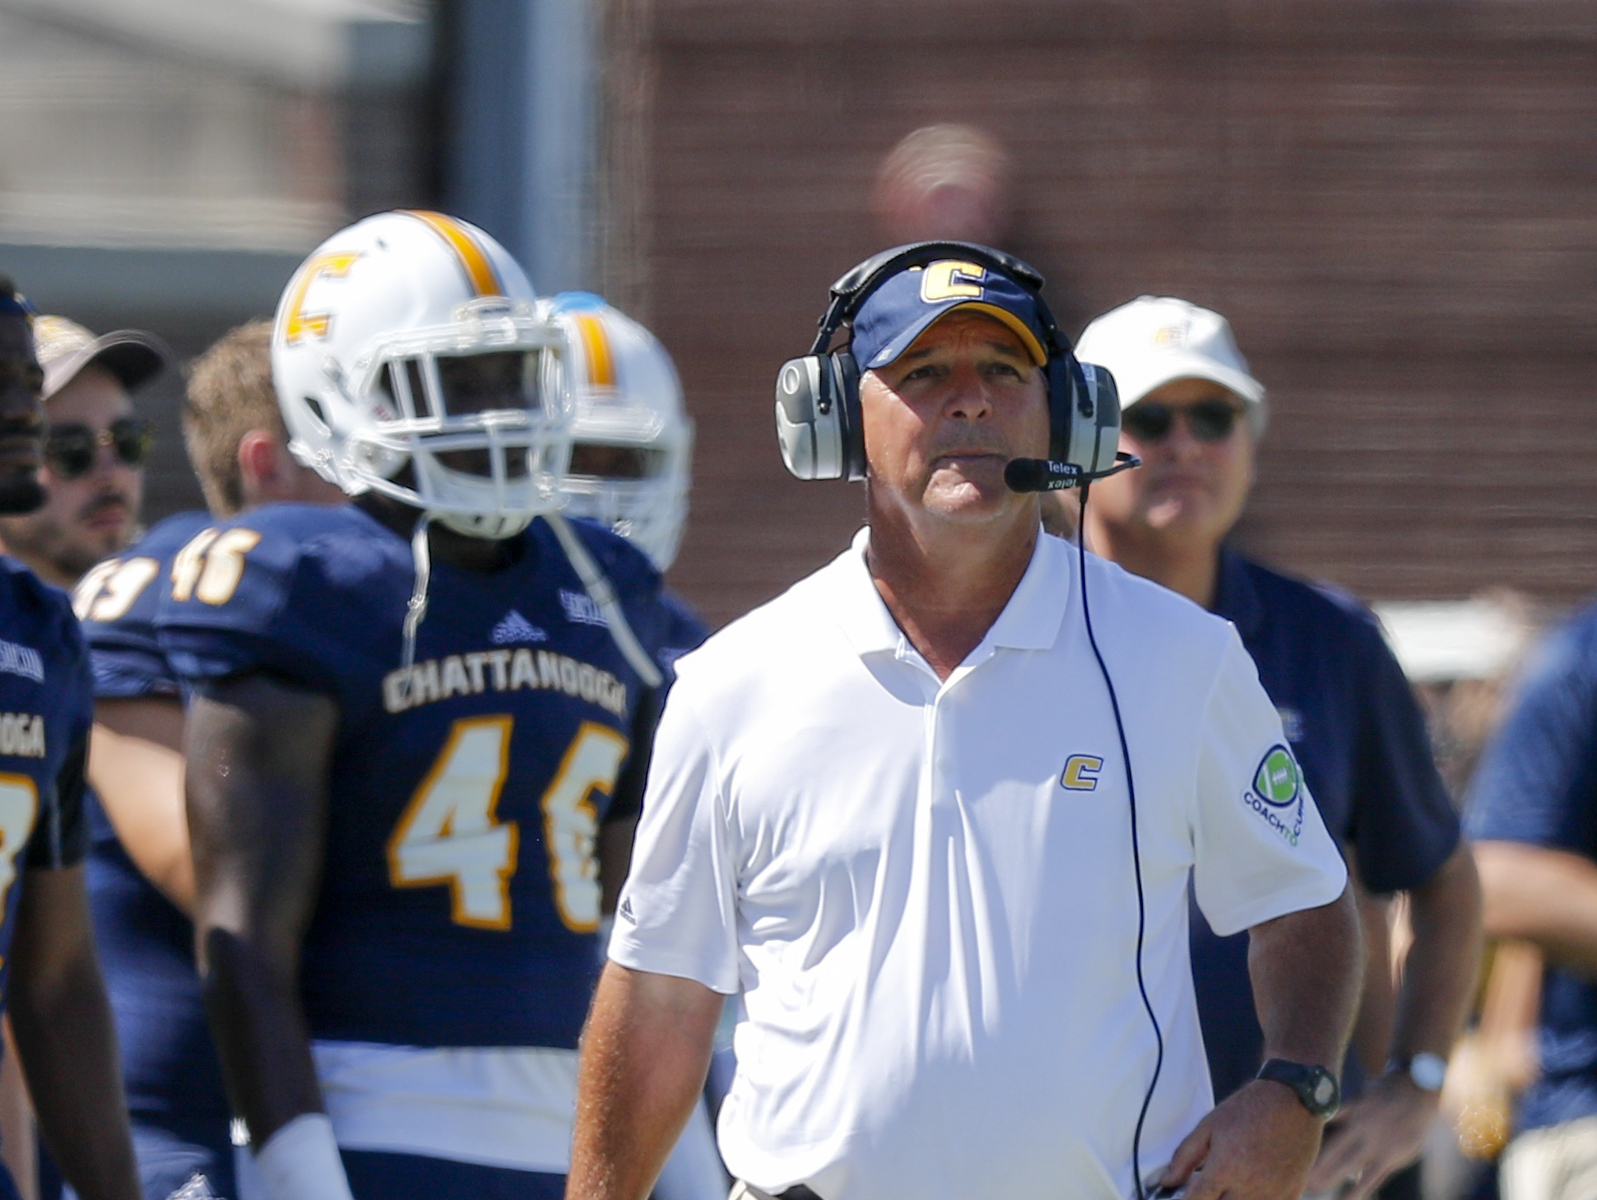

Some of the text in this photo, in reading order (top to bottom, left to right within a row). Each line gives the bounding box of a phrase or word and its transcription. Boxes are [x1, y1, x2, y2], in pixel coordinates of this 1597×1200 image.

[921, 259, 987, 303] C
[1047, 460, 1078, 475] Telex
[1047, 478, 1077, 490] Telex
[382, 648, 627, 714] CHATTANOOGA
[1060, 753, 1104, 792] C
[386, 713, 631, 934] 46
